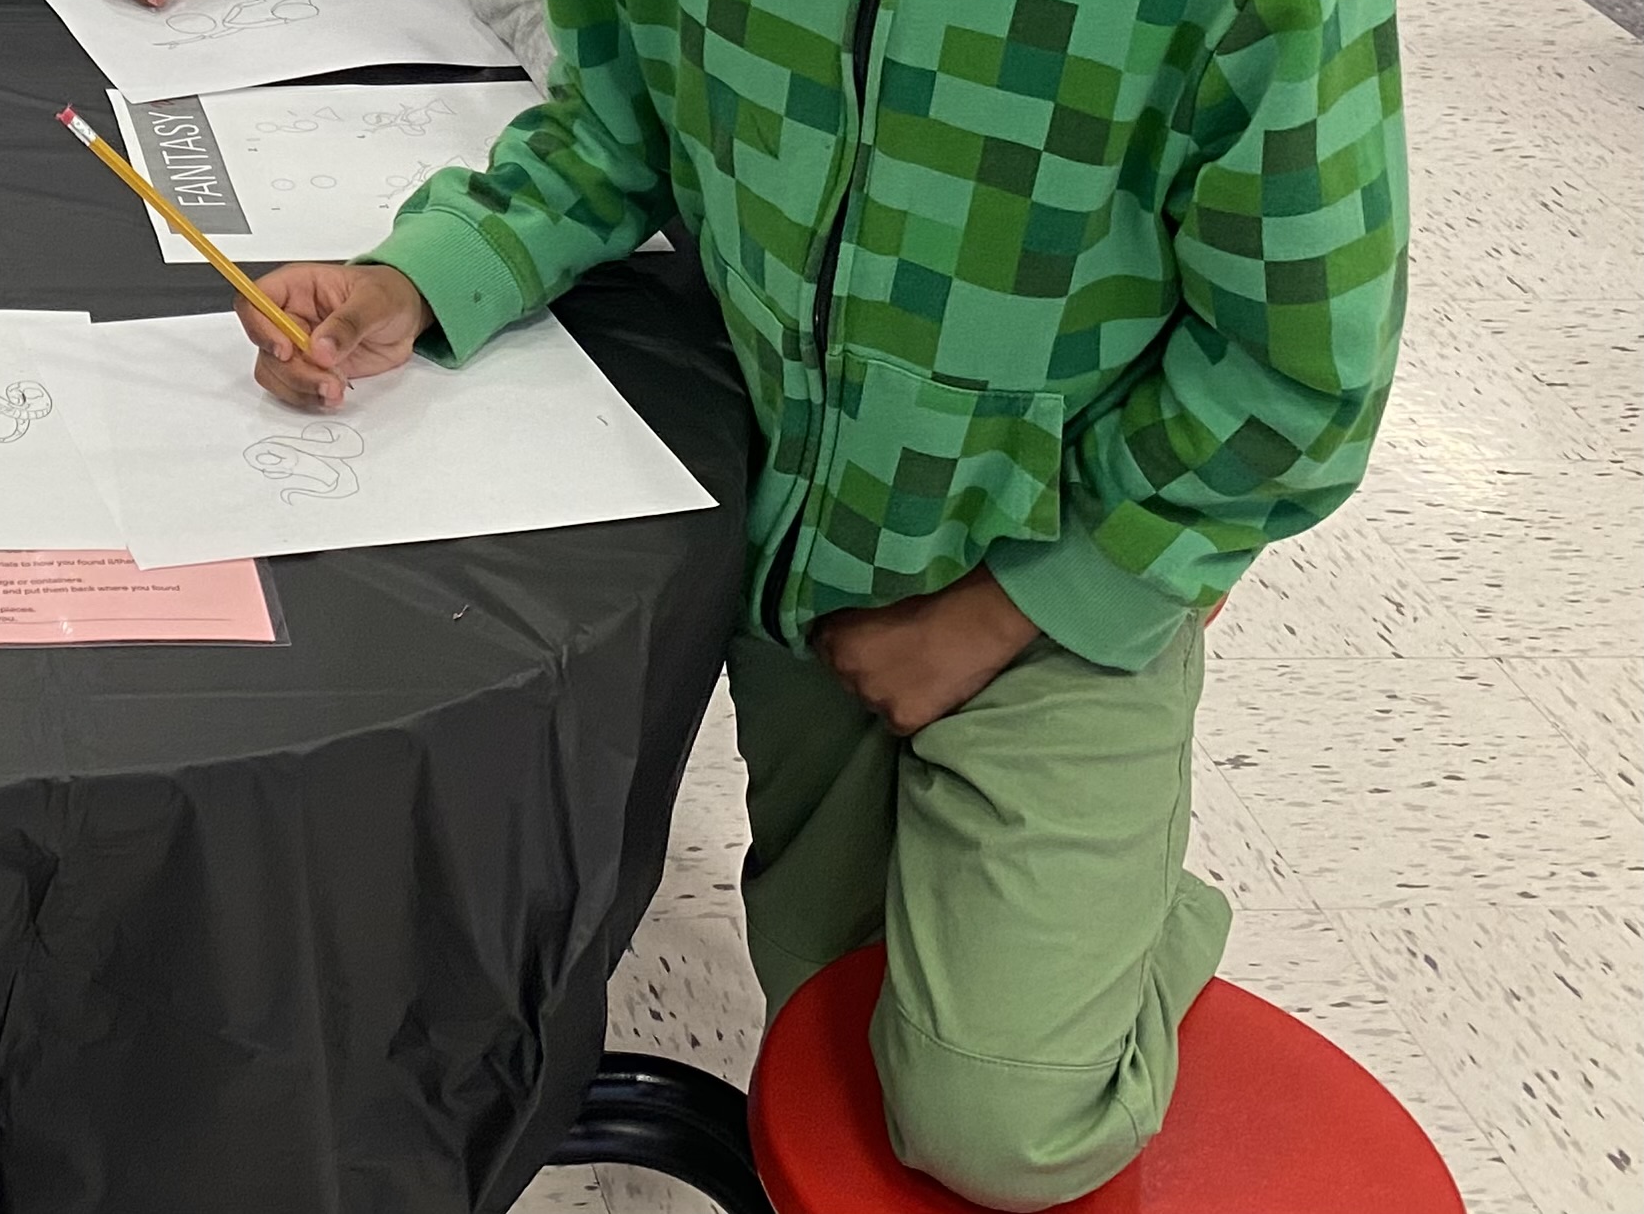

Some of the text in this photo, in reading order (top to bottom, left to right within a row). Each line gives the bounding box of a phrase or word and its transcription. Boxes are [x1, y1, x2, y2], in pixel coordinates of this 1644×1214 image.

[149, 111, 226, 207] FANTASY
[57, 560, 75, 568] you
[77, 558, 105, 566] found
[24, 588, 40, 596] put
[131, 585, 150, 593] you
[0, 606, 36, 614] pieces.
